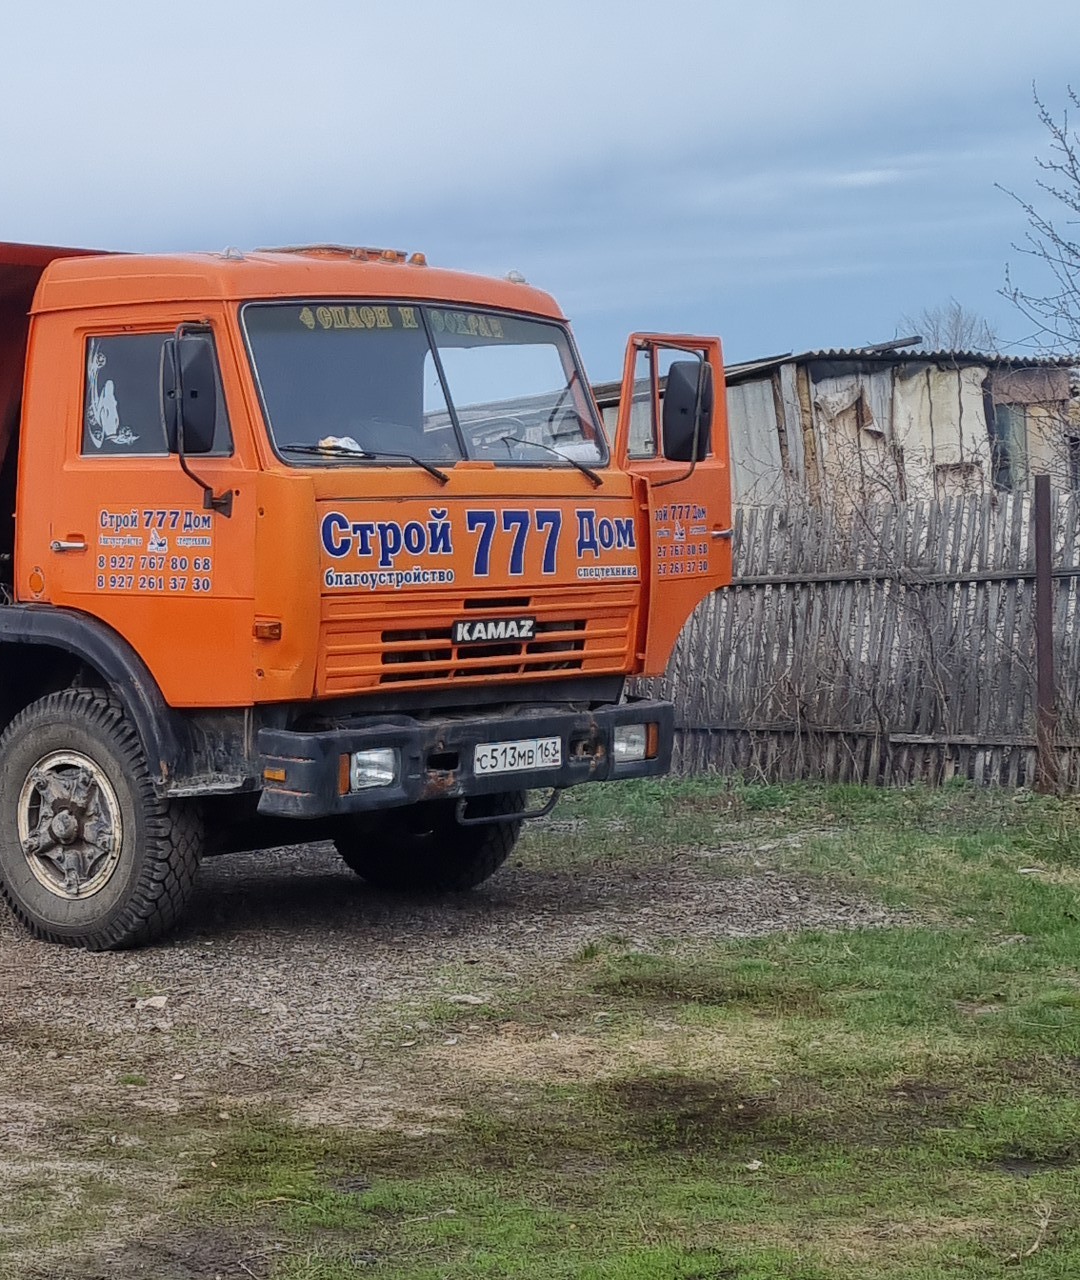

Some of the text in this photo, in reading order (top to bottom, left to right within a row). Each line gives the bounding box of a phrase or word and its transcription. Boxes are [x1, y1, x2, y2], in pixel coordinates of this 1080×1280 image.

[316, 306, 392, 329] СПАСИ
[670, 504, 690, 520] 777
[100, 510, 211, 532] Строй 777 Дом
[322, 509, 636, 576] Строй 777 Дом
[98, 556, 211, 570] 8 927 767 80 68
[687, 561, 696, 573] 37
[325, 567, 454, 588] благоустройство
[577, 565, 637, 579] спецтехника
[97, 575, 210, 590] 8 927 261 37 30
[456, 620, 533, 641] KAMAZ
[538, 741, 557, 758] 163
